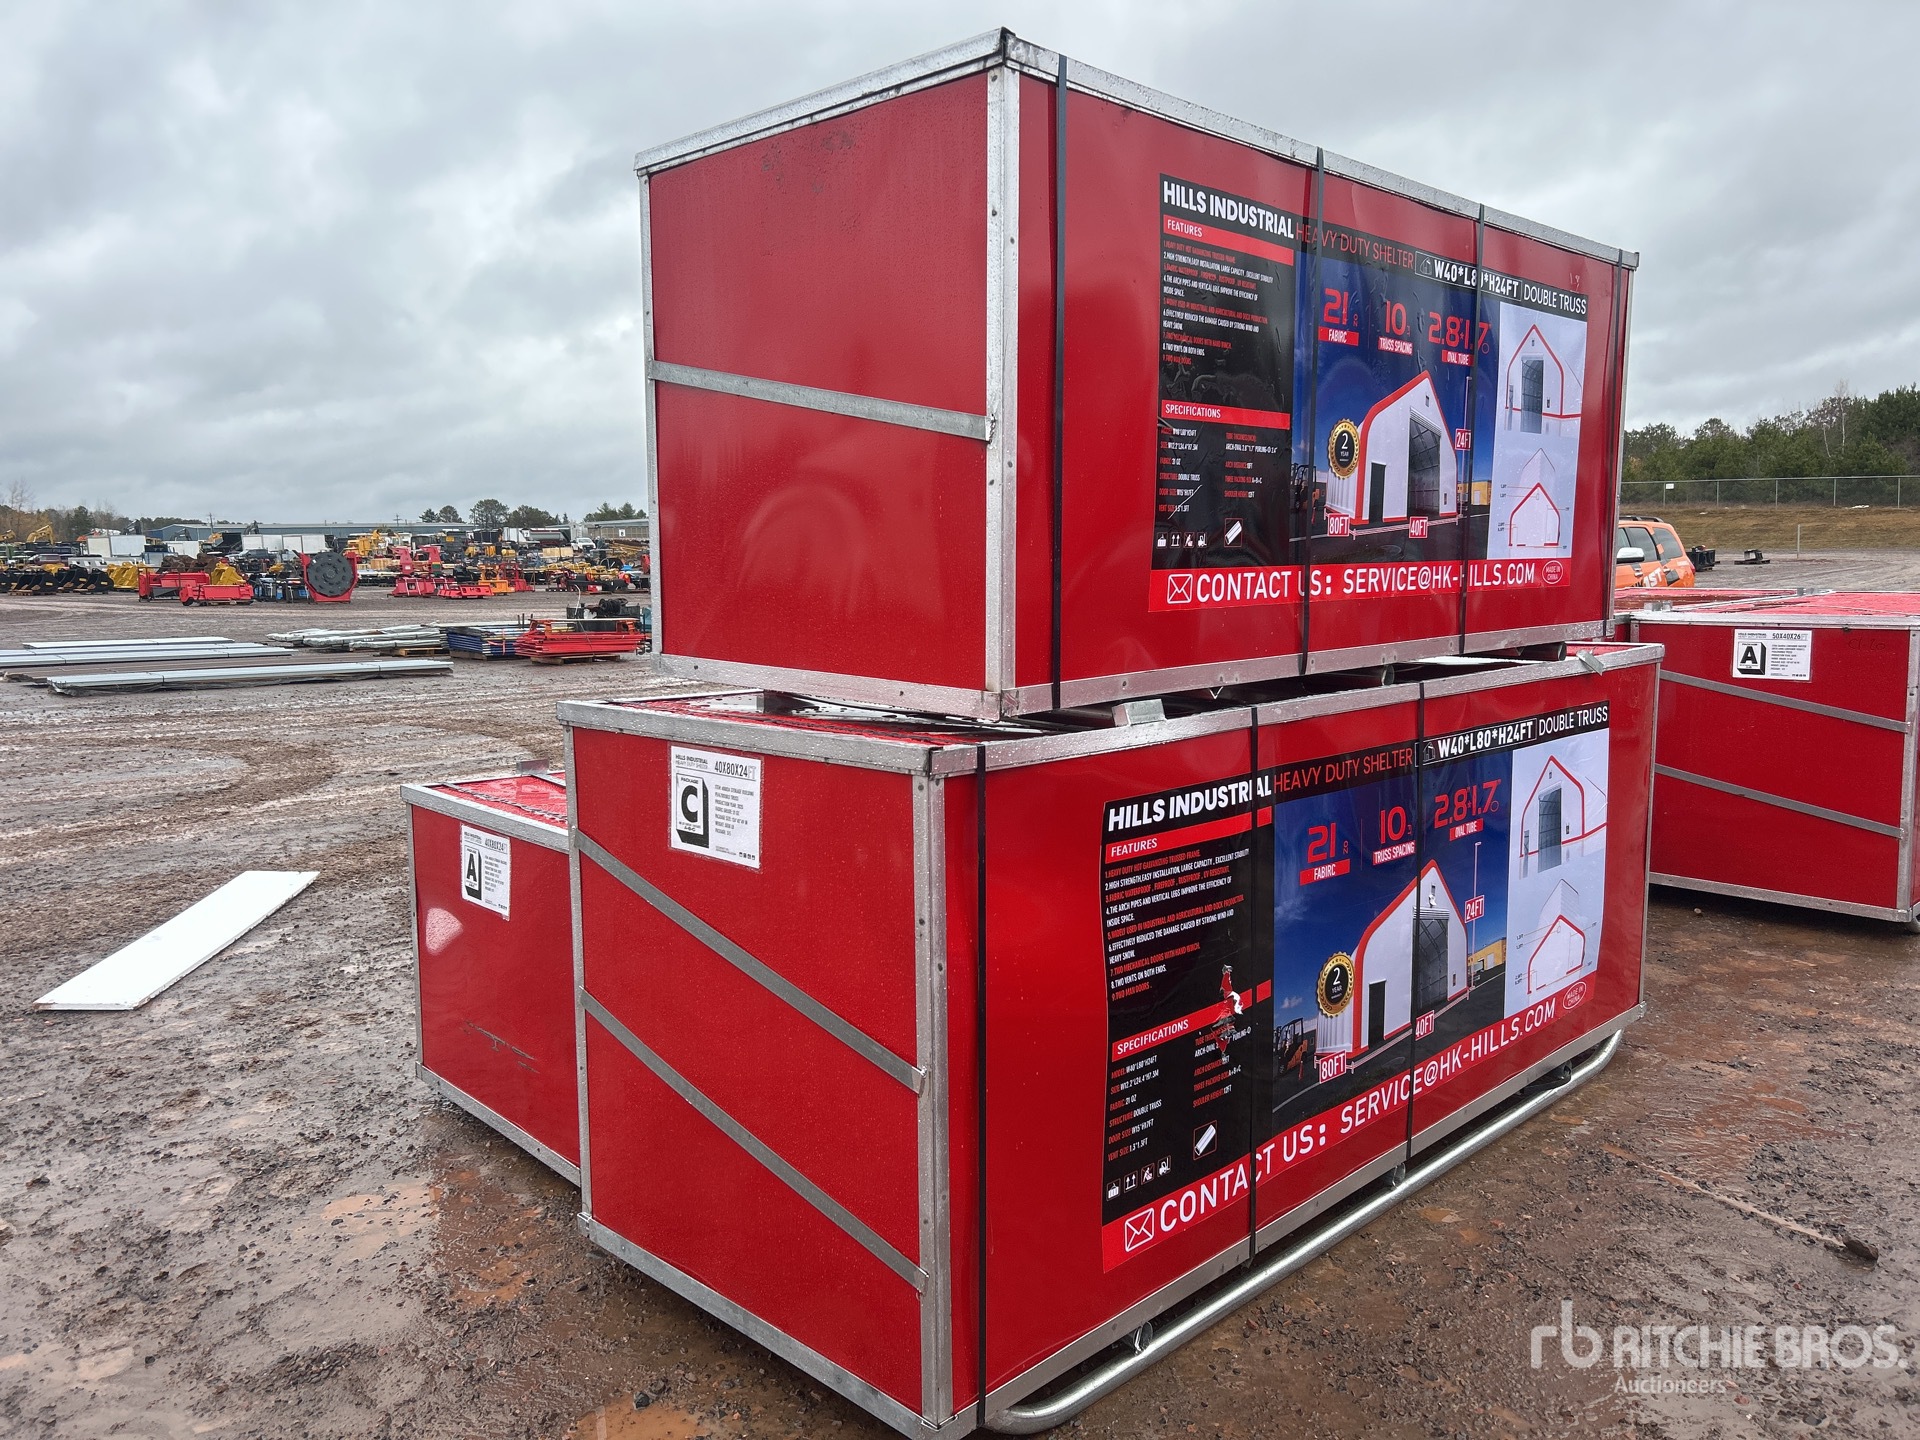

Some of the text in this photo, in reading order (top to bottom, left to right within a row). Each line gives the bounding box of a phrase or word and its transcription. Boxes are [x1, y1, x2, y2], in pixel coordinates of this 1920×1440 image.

[1167, 219, 1202, 238] FEATURES
[1163, 180, 1206, 213] HILLS
[1209, 194, 1295, 239] INDUSTRIAL
[1296, 222, 1338, 249] HEAVY
[1340, 233, 1371, 257] DUTY
[1372, 242, 1414, 270] SHELTER
[1523, 284, 1557, 308] DOUBLE
[1559, 293, 1587, 315] TRUSS
[1323, 288, 1348, 325] 21
[1385, 300, 1407, 336] 10
[1328, 330, 1347, 343] FABIRC
[1379, 337, 1413, 354] TRUSS SPACING
[1165, 403, 1221, 418] SPECIFICATIONS
[1341, 433, 1349, 450] 2
[1456, 432, 1471, 449] 24FT
[1329, 516, 1349, 535] 80FT
[1410, 518, 1427, 536] 40FT
[1196, 571, 1292, 603] CONTACT
[1740, 646, 1758, 664] A
[1108, 799, 1166, 832] HILLS
[1169, 775, 1272, 819] INDUSTRIAL
[1274, 765, 1322, 794] HEAVY
[1325, 757, 1360, 784] DUTY
[1363, 747, 1413, 775] SHELTER
[1538, 711, 1574, 736] DOUBLE
[1577, 705, 1608, 727] TRUSS
[681, 785, 698, 823] C
[1380, 806, 1407, 844] 10
[1111, 838, 1158, 858] FEATURES
[1307, 822, 1336, 864] 21
[1374, 841, 1415, 863] TRUSS SPACING
[466, 853, 477, 882] A
[1181, 861, 1193, 872] LARGE
[1194, 857, 1212, 868] CAPACITY
[1215, 852, 1234, 863] EXCELLENT
[1313, 864, 1336, 881] FABIRC
[1118, 901, 1130, 911] ARCH
[1131, 898, 1142, 908] PIPES
[1143, 896, 1151, 905] AND
[1152, 891, 1170, 903] VERTICAL
[1170, 889, 1180, 898] LEGS
[1181, 884, 1198, 896] IMPROVE
[1206, 877, 1226, 889] EFFICIENCY
[1227, 876, 1232, 884] OF
[1466, 898, 1484, 920] 24FT
[1106, 917, 1120, 927] INSIDE
[1136, 931, 1155, 944] REDUCED
[1163, 924, 1180, 936] DAMAGE
[1180, 920, 1195, 931] CAUSED
[1196, 918, 1201, 927] BY
[1202, 914, 1217, 925] STRONG
[1109, 954, 1122, 964] HEAVY
[1124, 974, 1137, 985] VENTS
[1138, 972, 1143, 980] ON
[1144, 968, 1155, 978] BOTH
[1332, 967, 1341, 986] 2
[1331, 985, 1343, 993] YEAR
[1415, 1013, 1434, 1037] 40FT
[1117, 1019, 1189, 1055] SPECIFICATIONS
[1321, 1052, 1346, 1080] 80FT
[1149, 1099, 1162, 1111] TRUSS
[1160, 998, 1556, 1232] CONTACT US: SERVICE@HK-HILLS.COM
